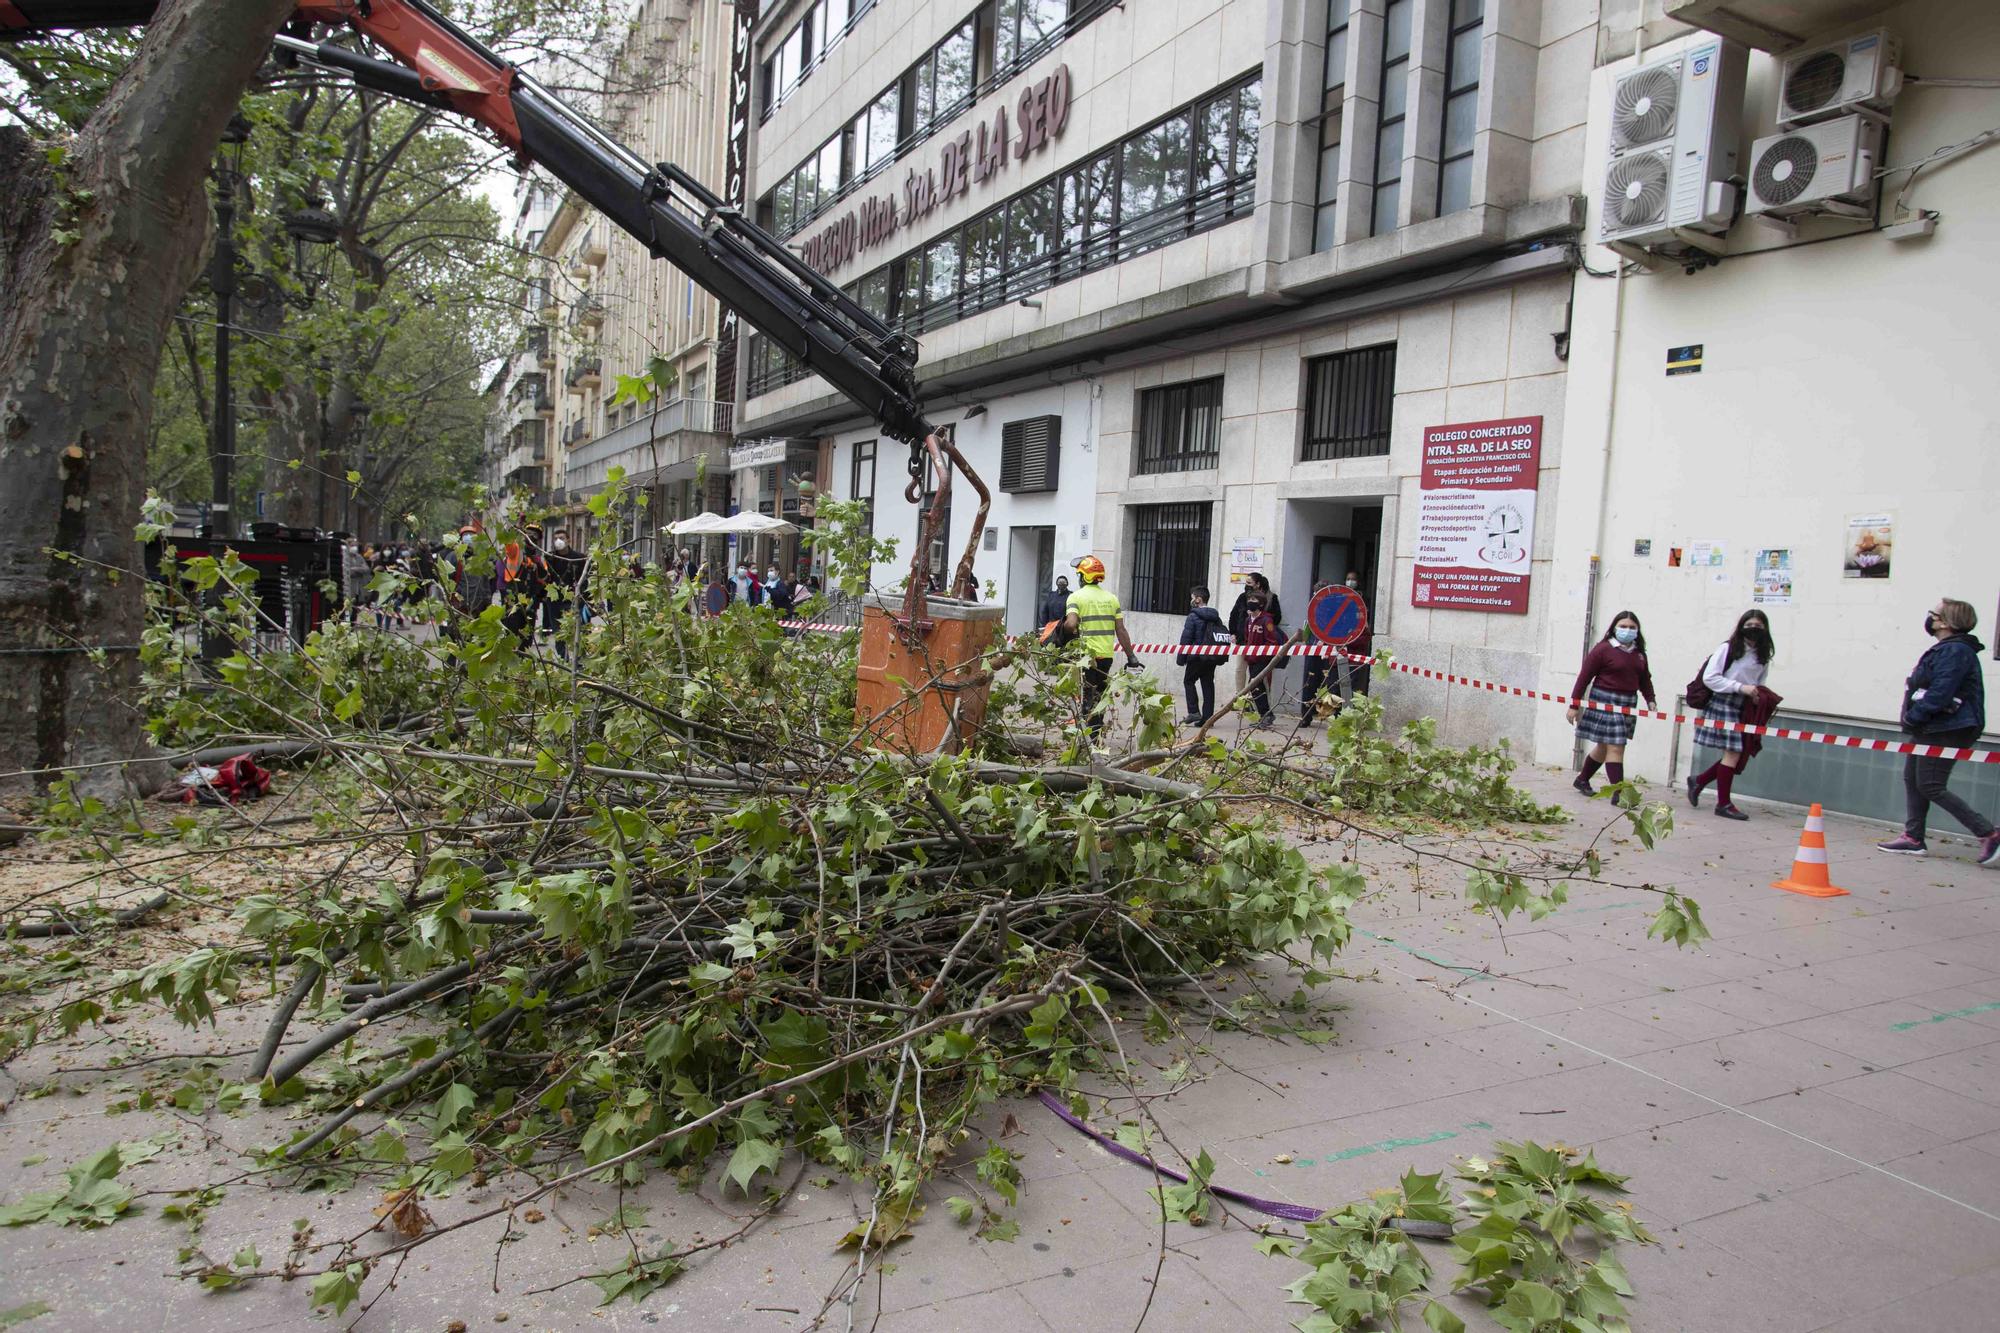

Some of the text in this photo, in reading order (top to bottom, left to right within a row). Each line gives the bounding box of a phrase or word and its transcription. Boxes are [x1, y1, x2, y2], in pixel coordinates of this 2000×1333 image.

[938, 129, 970, 204] DE
[974, 105, 1005, 184] LA
[1014, 63, 1070, 160] SEO
[1430, 425, 1532, 443] COLEGIO CONCERTADO
[1427, 439, 1532, 456] NTRA. SRA. DE LA SEO
[1426, 456, 1455, 465] FUNDACIÓN
[1456, 455, 1485, 463] EDUCATIVA
[1434, 464, 1522, 477] Etapas: Educación Infantil,
[1440, 475, 1512, 486] Primaria y Secundaria
[1450, 583, 1470, 591] FORMA
[1433, 595, 1512, 606] www.dominicasxativa.es
